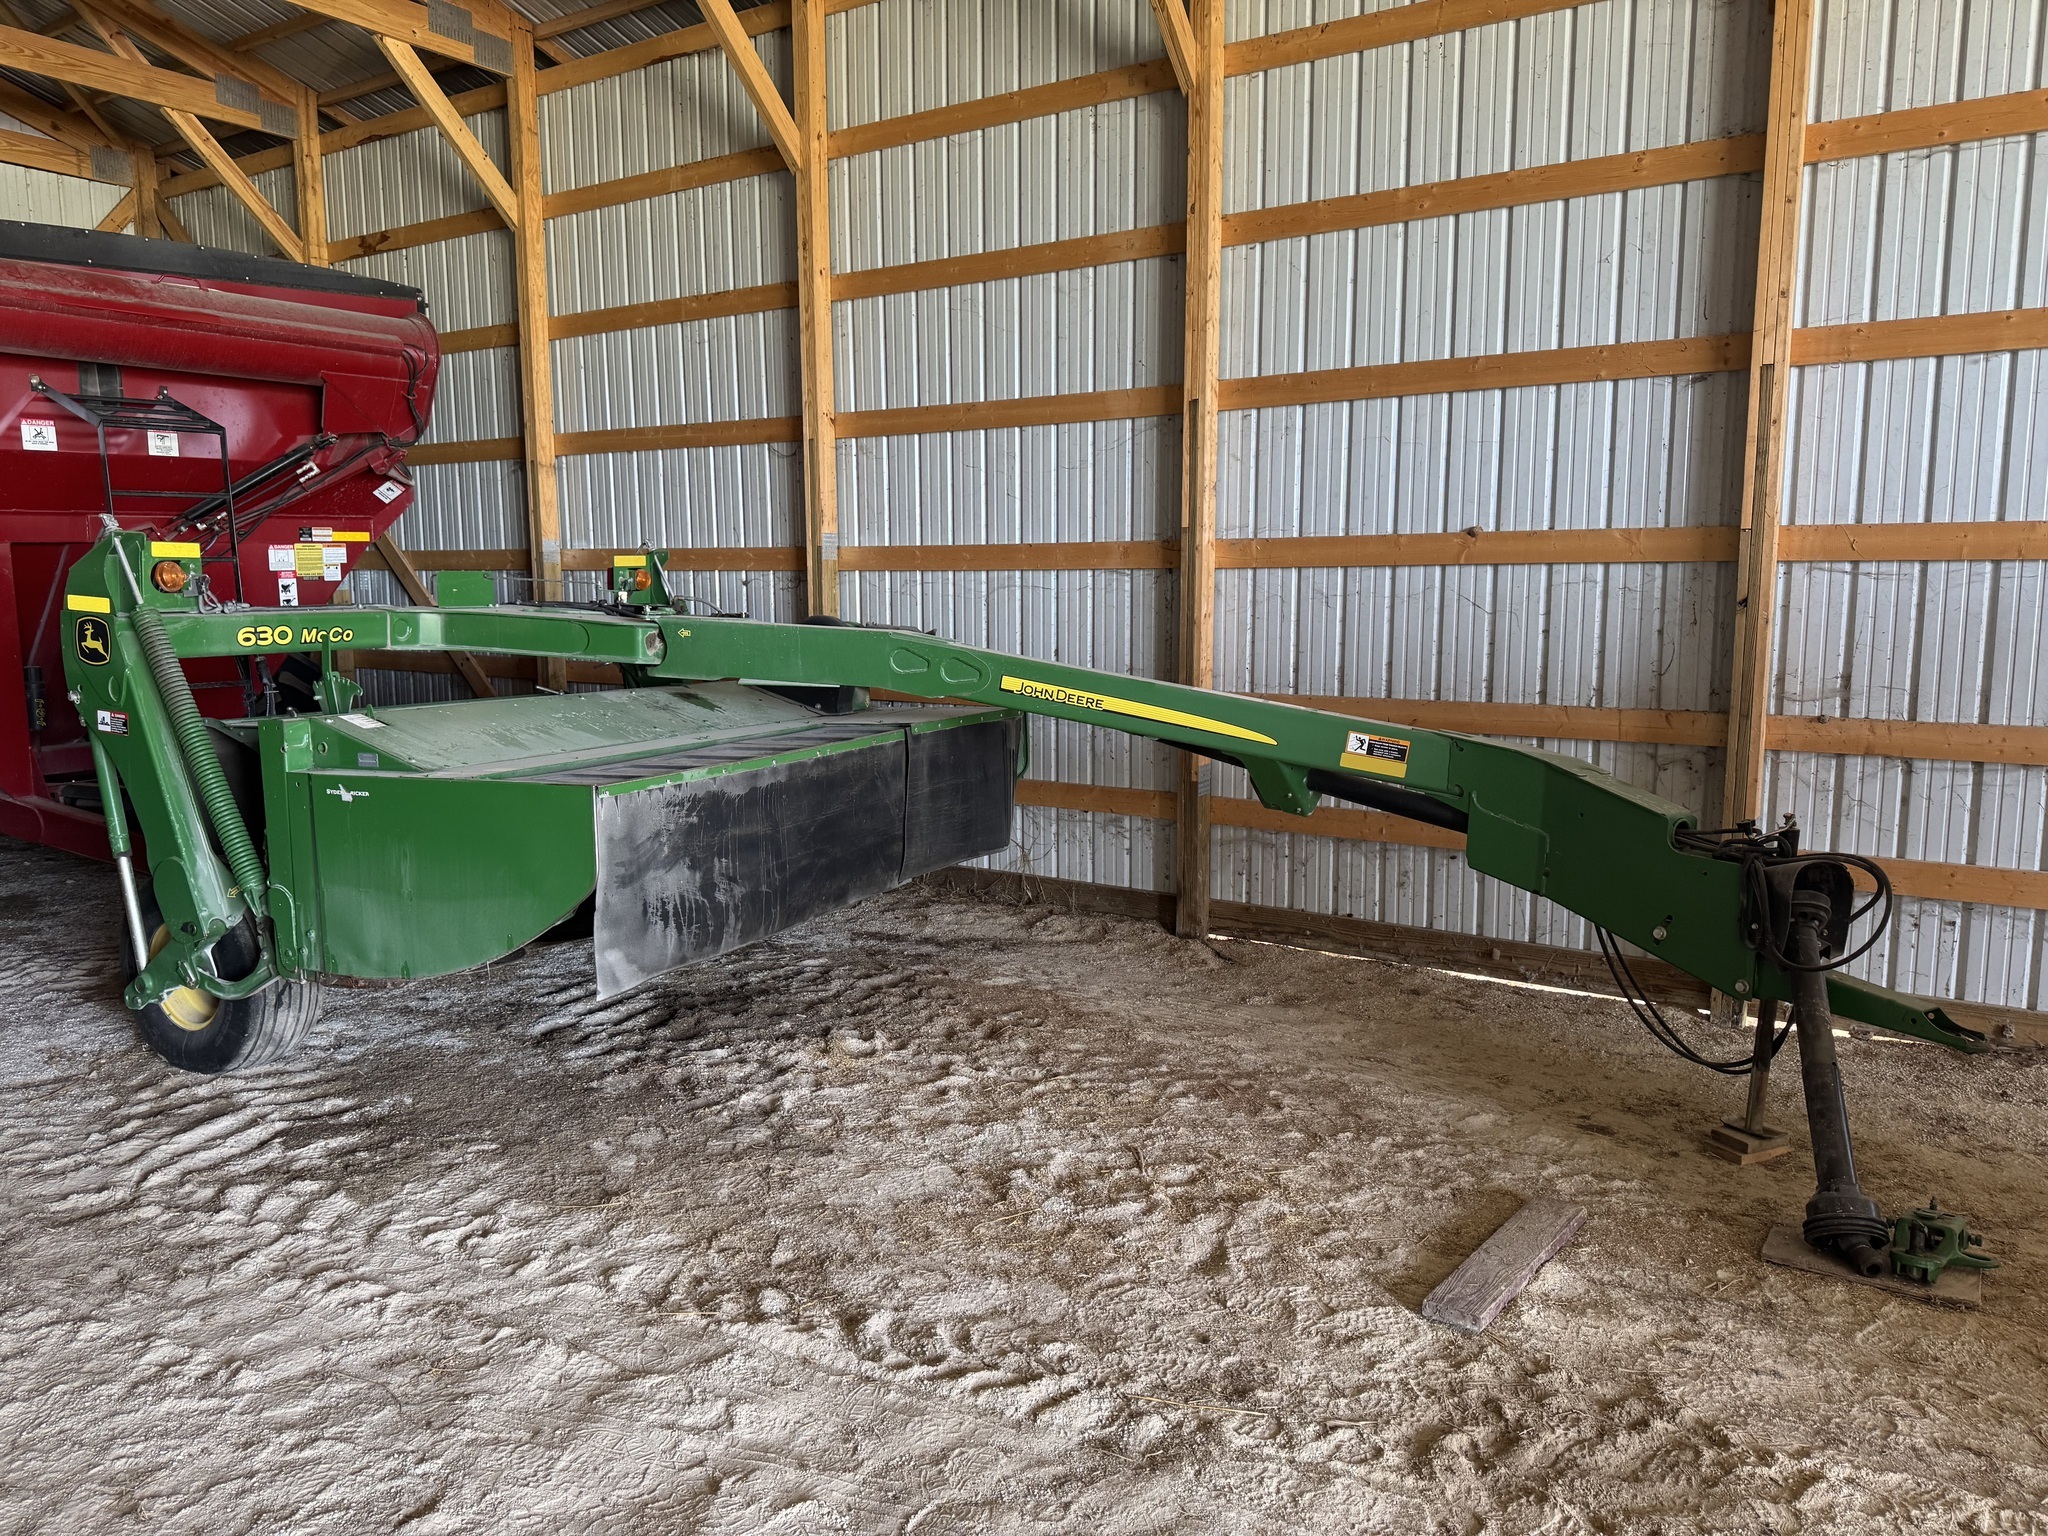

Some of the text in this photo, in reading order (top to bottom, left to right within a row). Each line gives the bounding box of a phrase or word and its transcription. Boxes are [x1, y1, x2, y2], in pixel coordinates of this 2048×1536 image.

[237, 625, 293, 647] 630
[1015, 681, 1105, 709] JOHN DEERE
[326, 788, 370, 797] SYDERICKER
